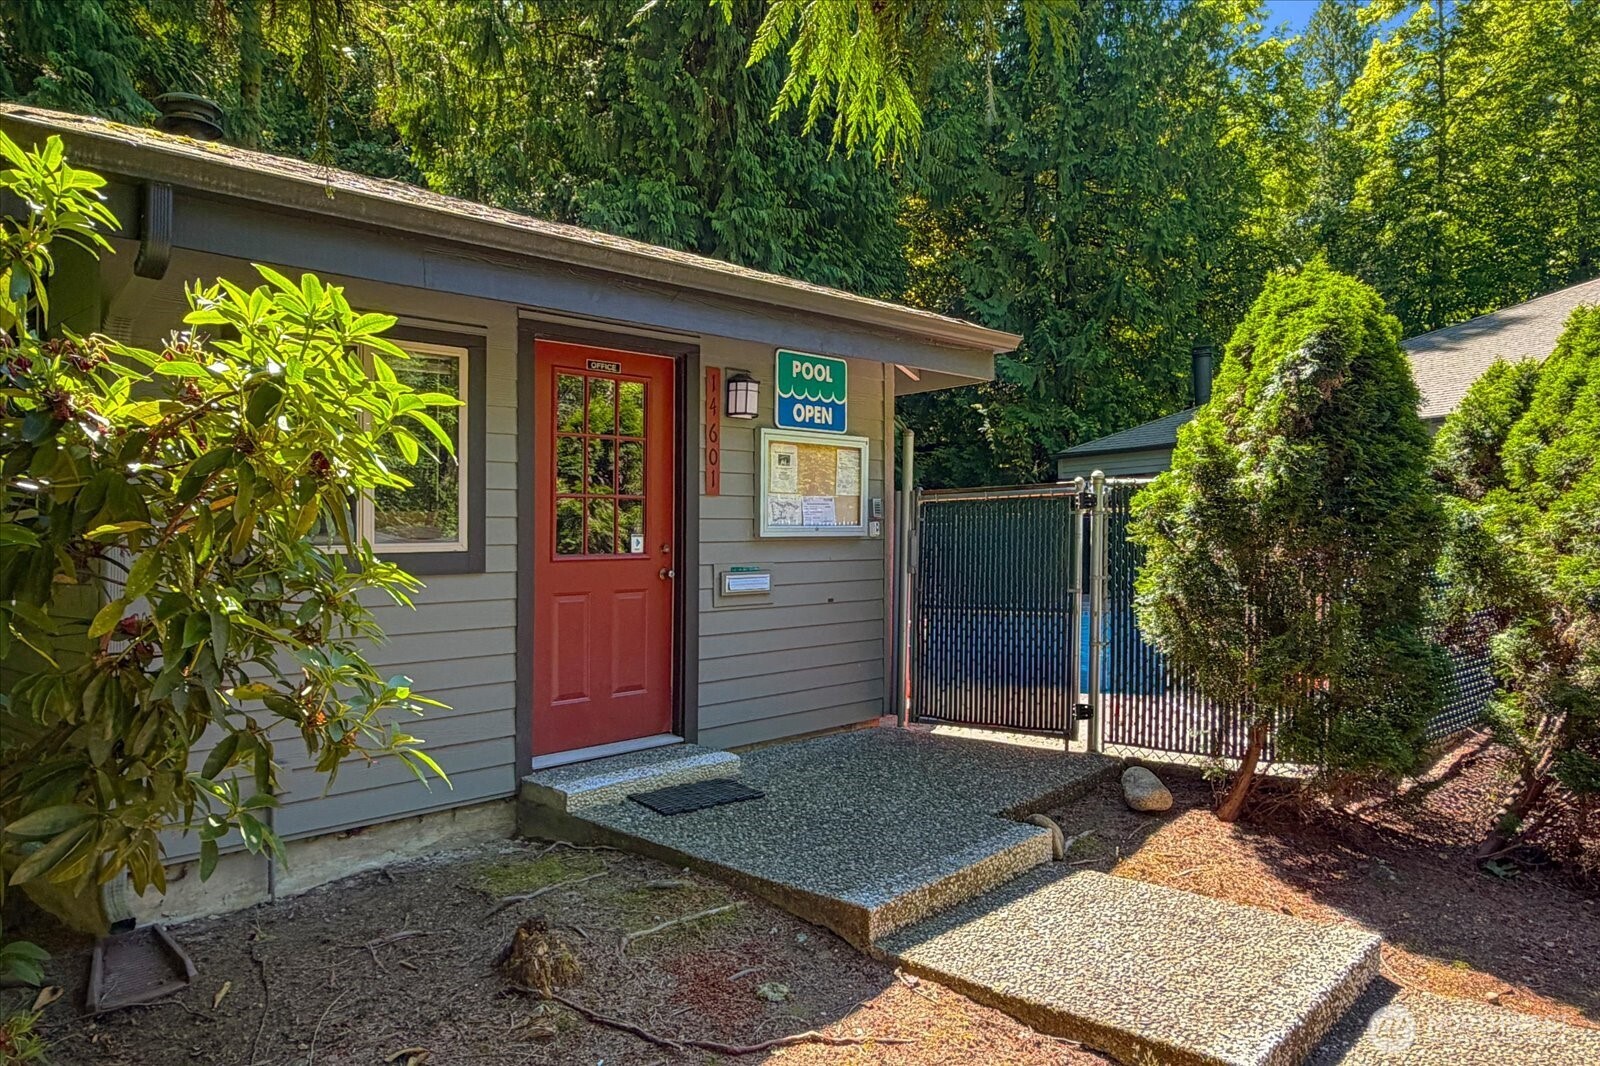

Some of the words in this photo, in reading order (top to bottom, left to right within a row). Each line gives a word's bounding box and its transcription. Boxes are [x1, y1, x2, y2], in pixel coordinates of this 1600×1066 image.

[590, 361, 617, 371] OFFICE
[792, 360, 833, 383] POOL
[792, 403, 833, 425] OPEN
[708, 374, 718, 488] 14601
